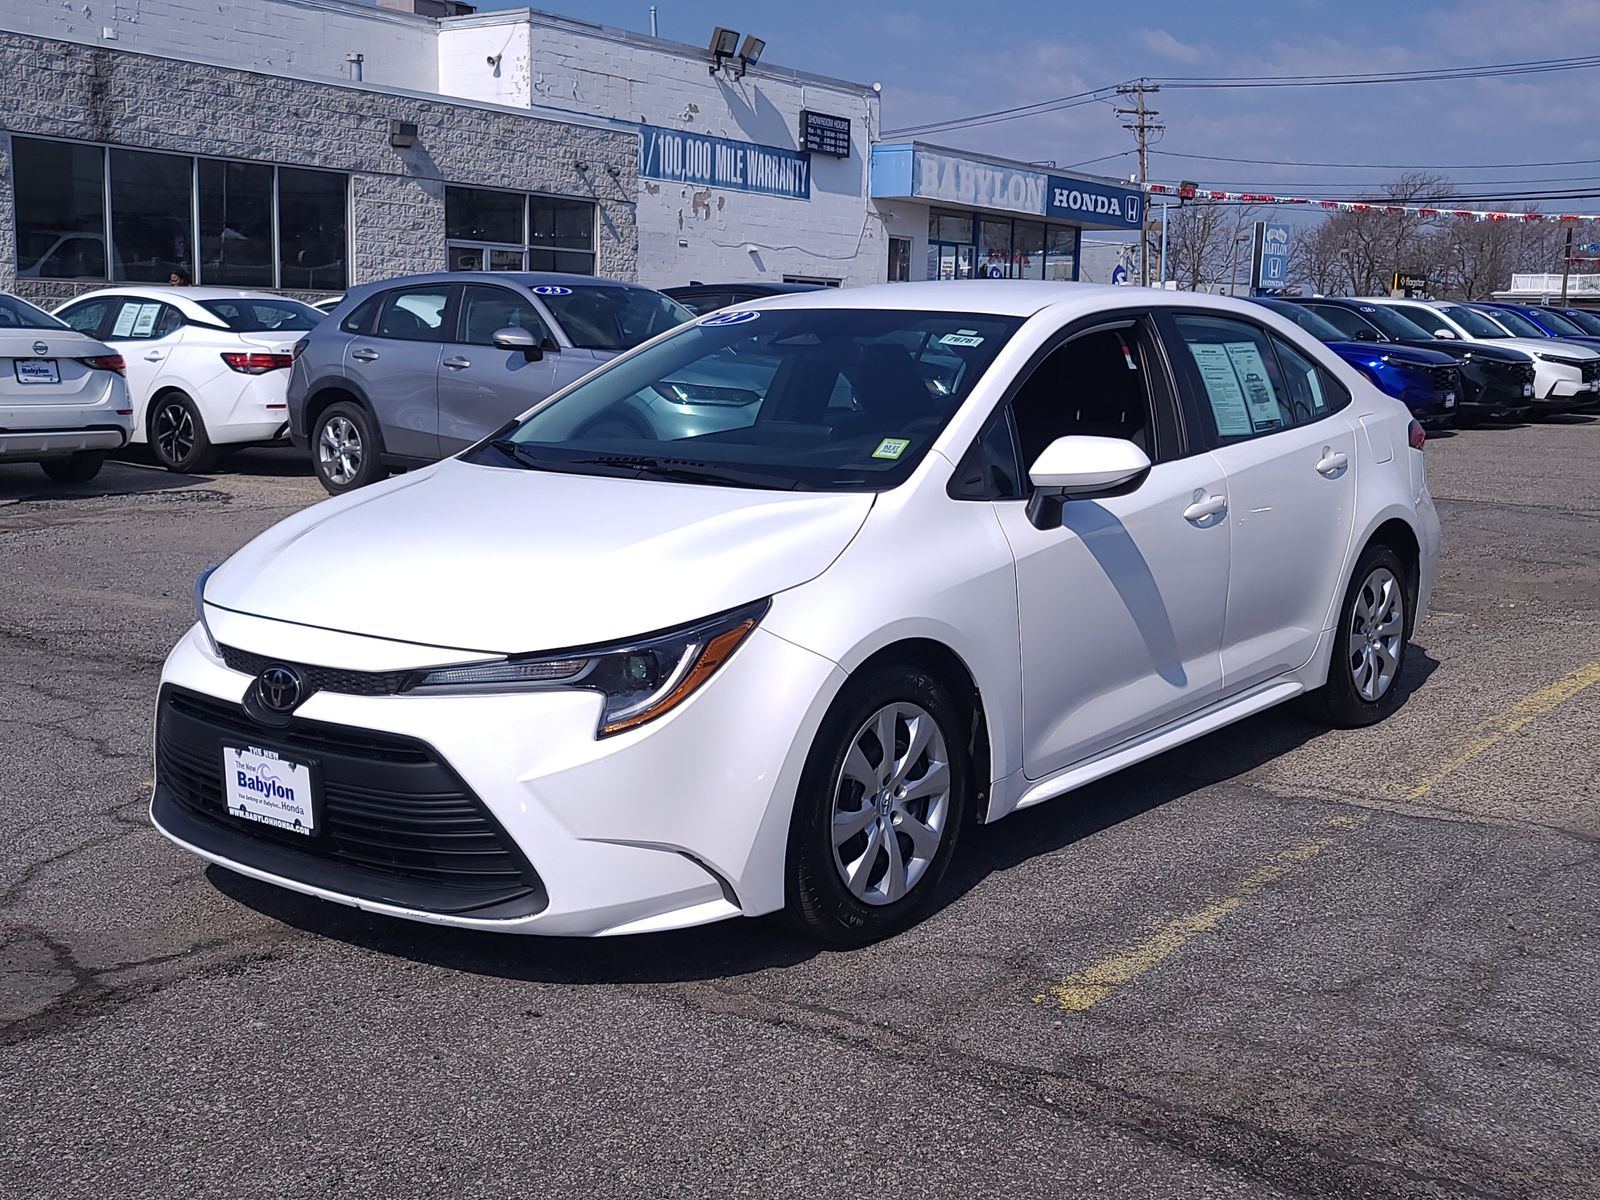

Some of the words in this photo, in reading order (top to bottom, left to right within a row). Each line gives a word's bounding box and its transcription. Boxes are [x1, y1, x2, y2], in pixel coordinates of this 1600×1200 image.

[834, 120, 848, 130] HOURS
[715, 144, 744, 184] MILE
[746, 149, 807, 193] WARRANTY
[919, 157, 1045, 211] BABYLON
[1053, 188, 1122, 216] HONDA
[544, 286, 561, 294] 23
[1262, 280, 1285, 288] HONDA
[21, 367, 50, 375] Babylon
[248, 746, 263, 758] THE
[263, 749, 279, 761] NEW
[235, 760, 245, 770] The
[246, 763, 257, 773] New
[237, 770, 295, 801] Babylon
[281, 801, 305, 816] Honda
[229, 807, 311, 836] WWW.BABYLONHONDA.COM
